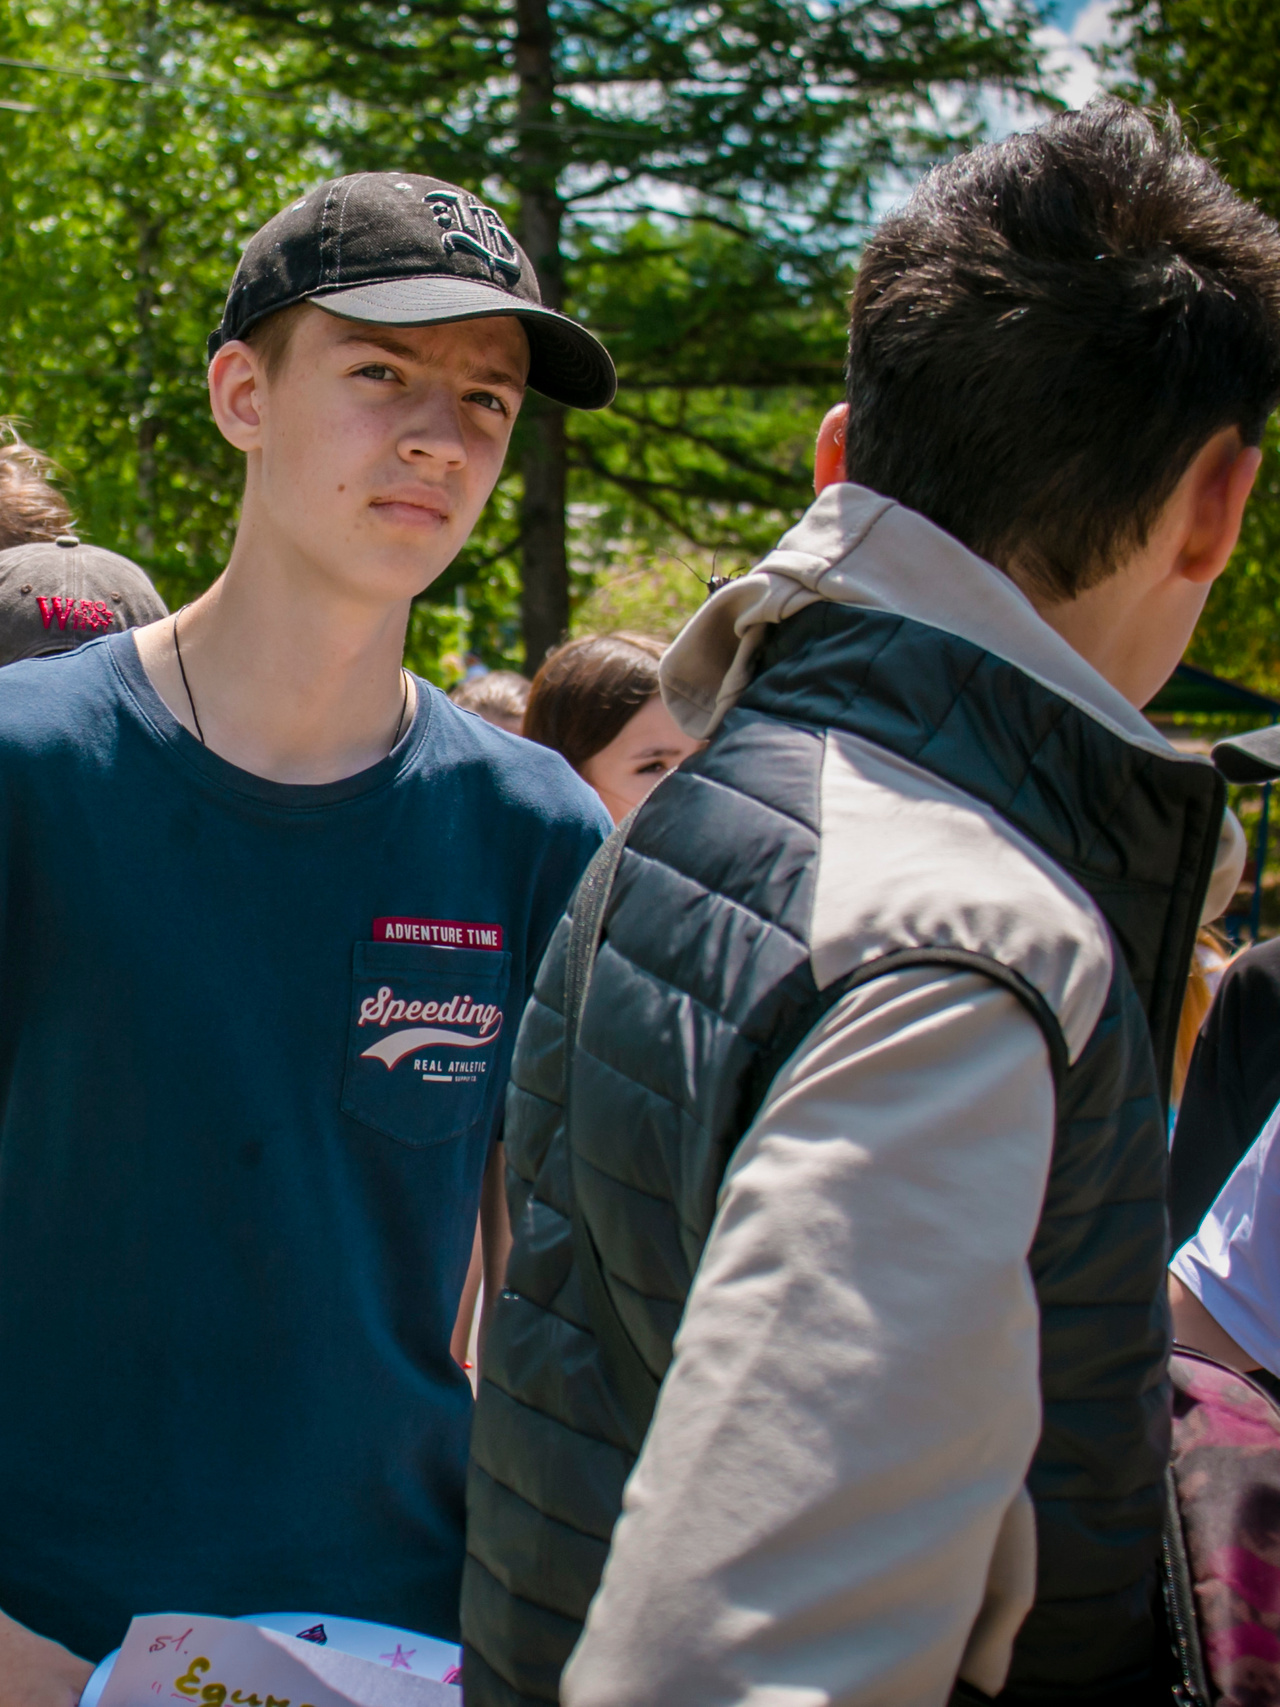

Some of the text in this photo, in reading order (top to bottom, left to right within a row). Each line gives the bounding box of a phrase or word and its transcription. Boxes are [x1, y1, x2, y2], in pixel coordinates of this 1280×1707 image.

[384, 923, 498, 947] ADVENTURE TIME
[357, 986, 499, 1036] Speeding
[414, 1059, 487, 1073] REAL ATHLETIC
